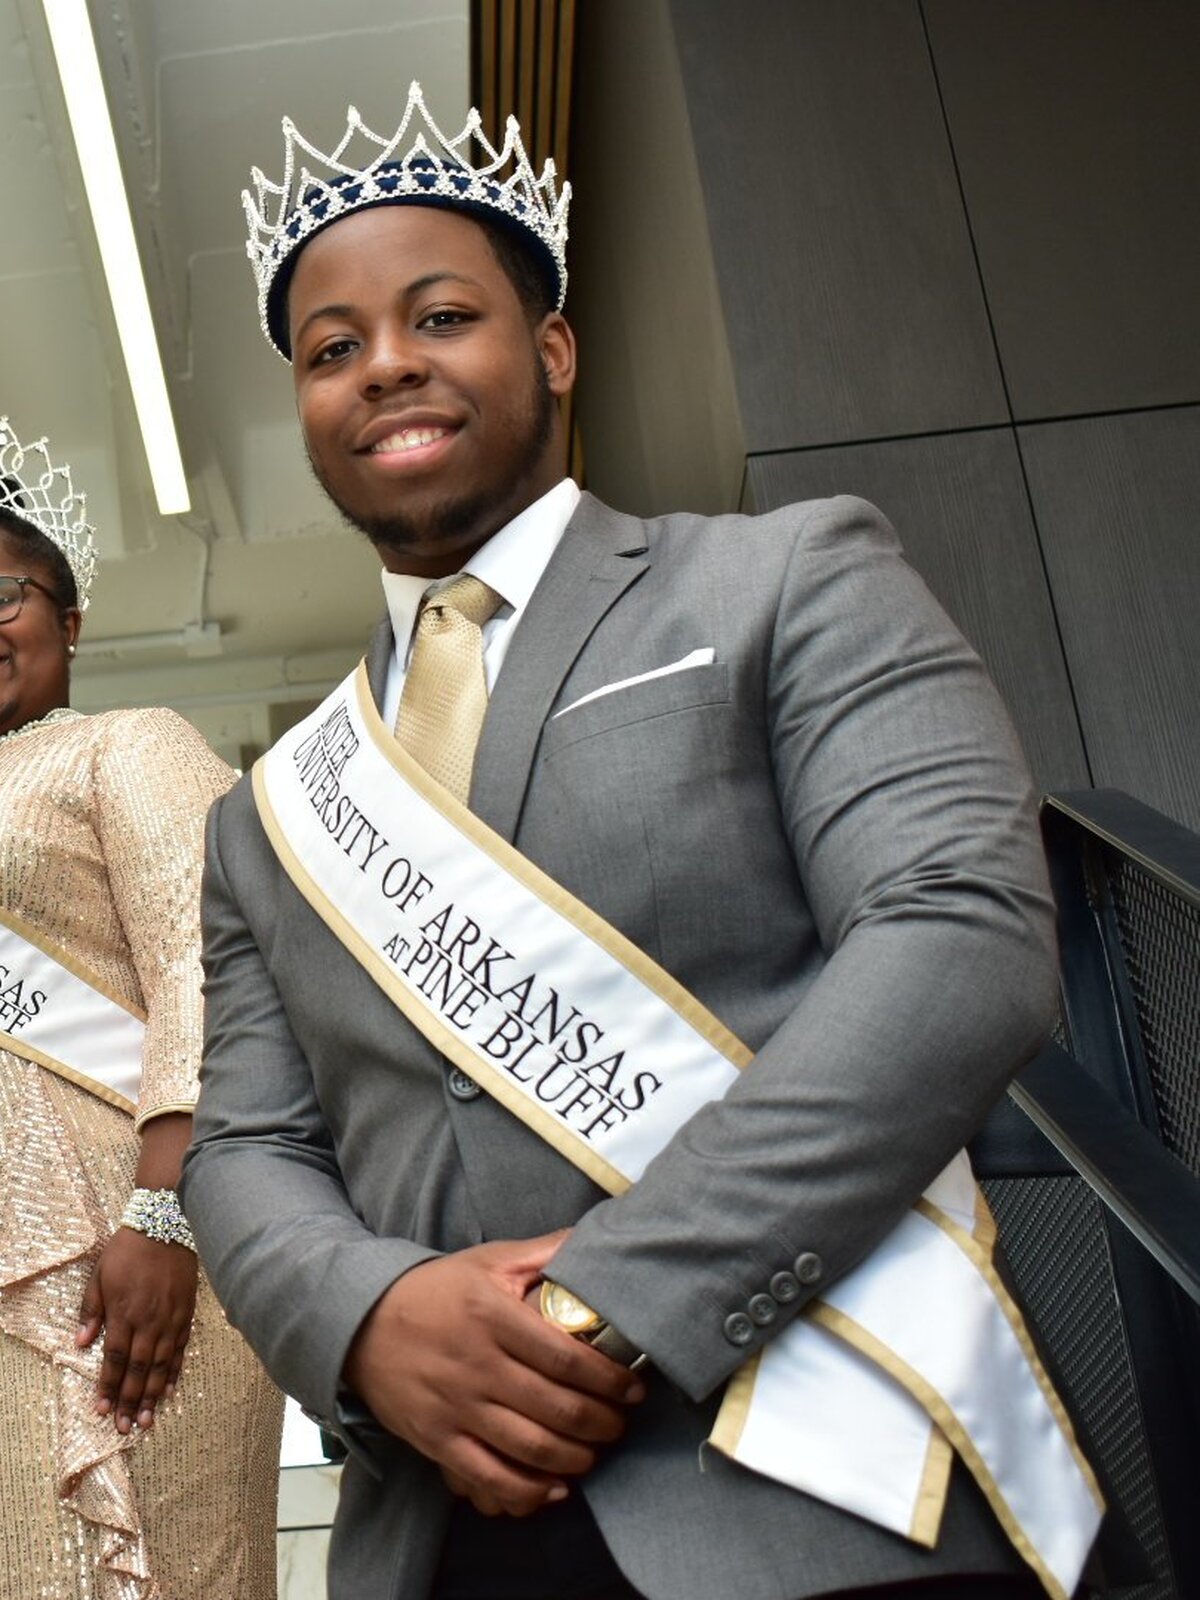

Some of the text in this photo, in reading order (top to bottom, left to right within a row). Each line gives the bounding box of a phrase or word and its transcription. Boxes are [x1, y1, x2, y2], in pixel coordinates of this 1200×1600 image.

[321, 698, 360, 778] MISTER
[293, 728, 662, 1110] UNIVERSITY OF ARKANSAS
[383, 933, 628, 1140] AT PINE BLUFF
